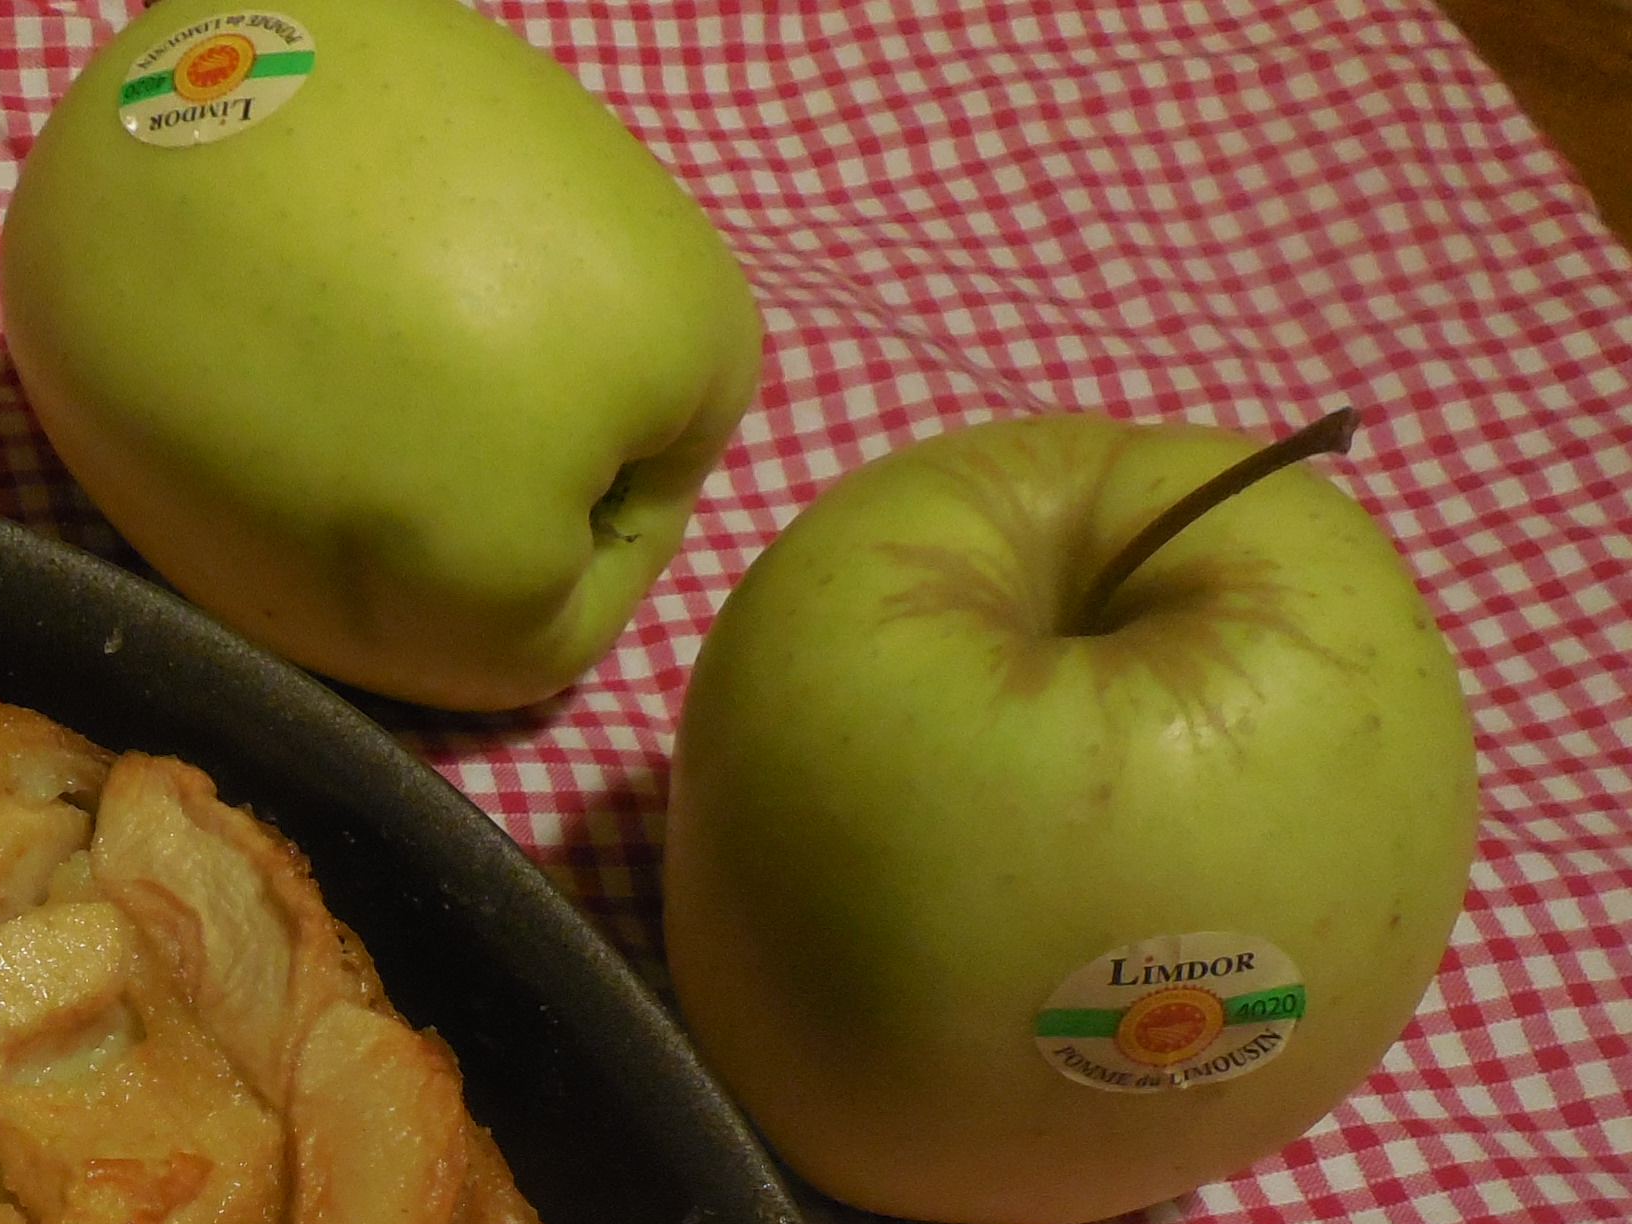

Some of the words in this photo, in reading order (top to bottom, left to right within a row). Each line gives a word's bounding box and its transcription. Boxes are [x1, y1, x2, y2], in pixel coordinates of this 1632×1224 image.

[136, 18, 221, 70] LIMOUSIN
[1236, 993, 1298, 1018] 4020
[1053, 1043, 1134, 1086] POMME
[1135, 1074, 1160, 1088] du
[1169, 1028, 1285, 1085] LIMOUSIN
